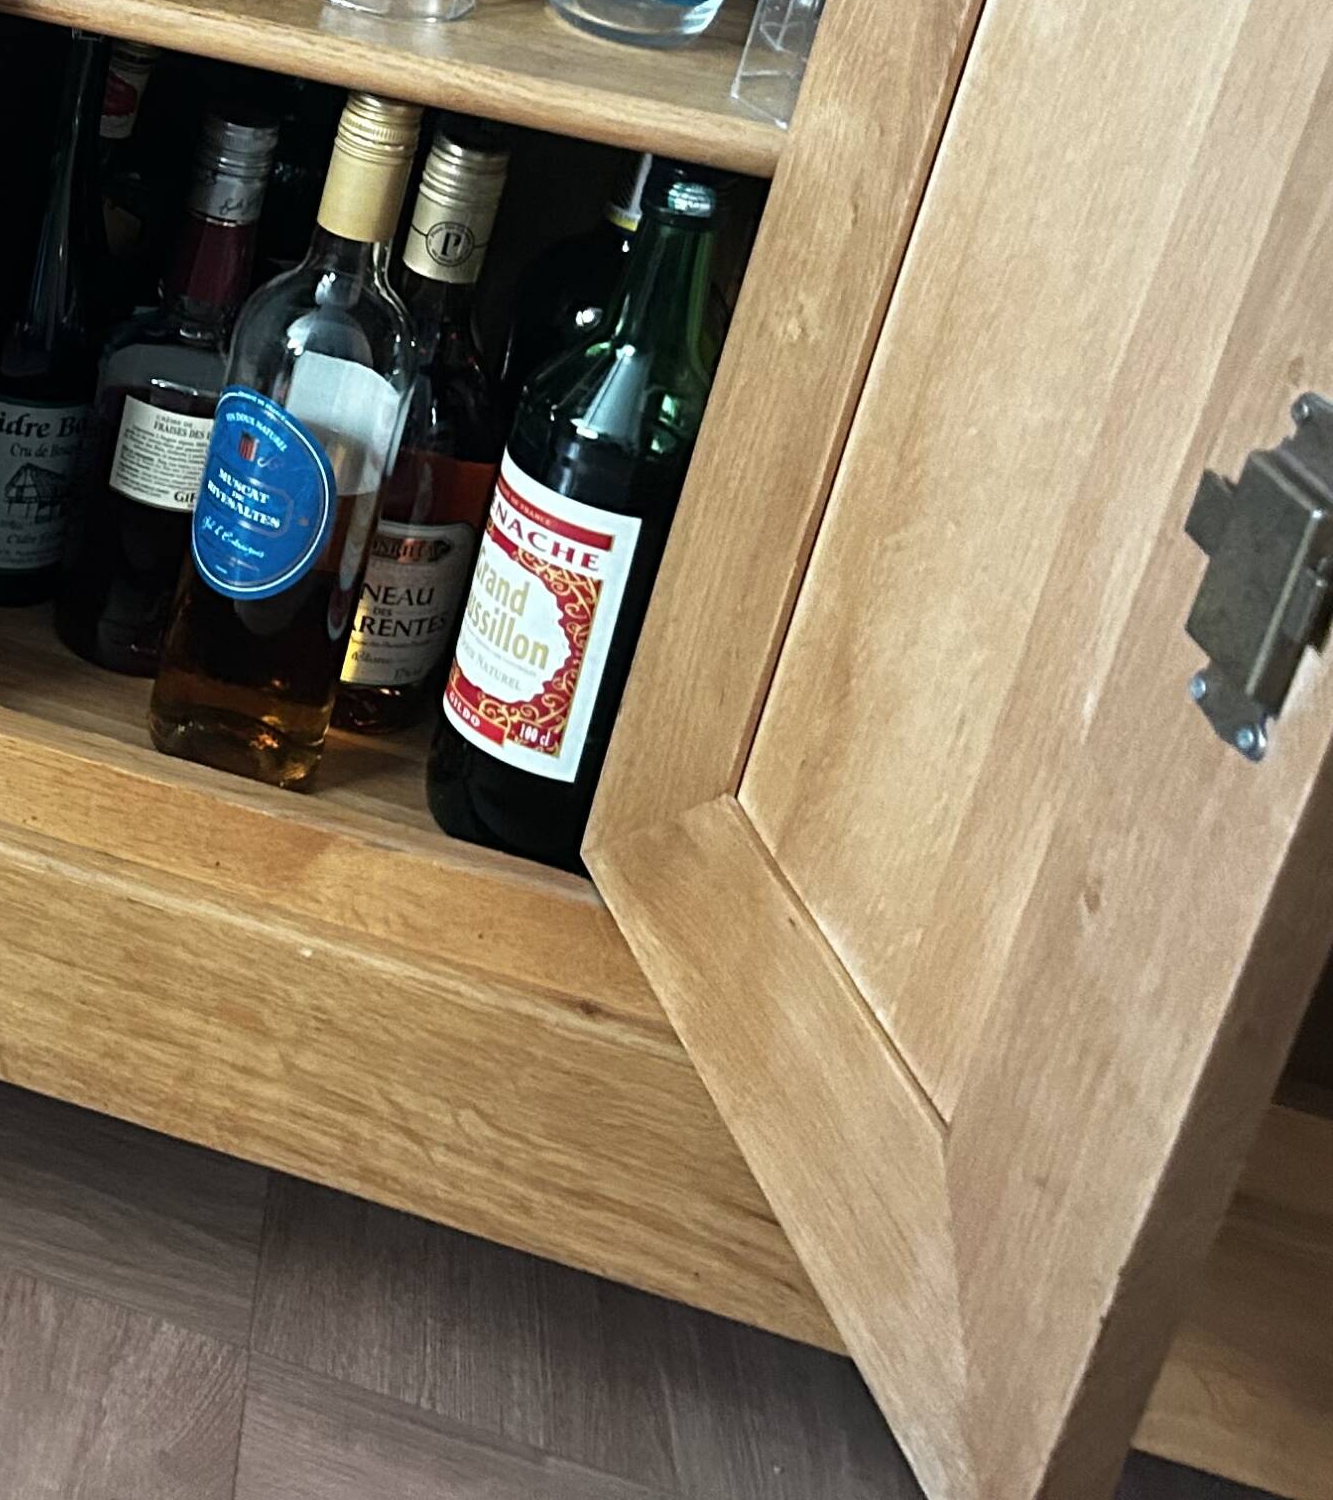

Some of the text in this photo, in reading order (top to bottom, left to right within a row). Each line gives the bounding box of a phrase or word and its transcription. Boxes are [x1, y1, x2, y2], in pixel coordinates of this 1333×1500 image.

[441, 231, 462, 256] P
[153, 420, 188, 437] FRAISES
[189, 429, 205, 440] DES
[255, 419, 288, 453] NATUREL
[10, 442, 32, 458] Cru
[218, 467, 270, 504] MUSCAT
[207, 479, 281, 529] RIVESALTES
[519, 503, 551, 526] FRANCE
[448, 691, 481, 728] GILDO
[519, 723, 539, 743] 100
